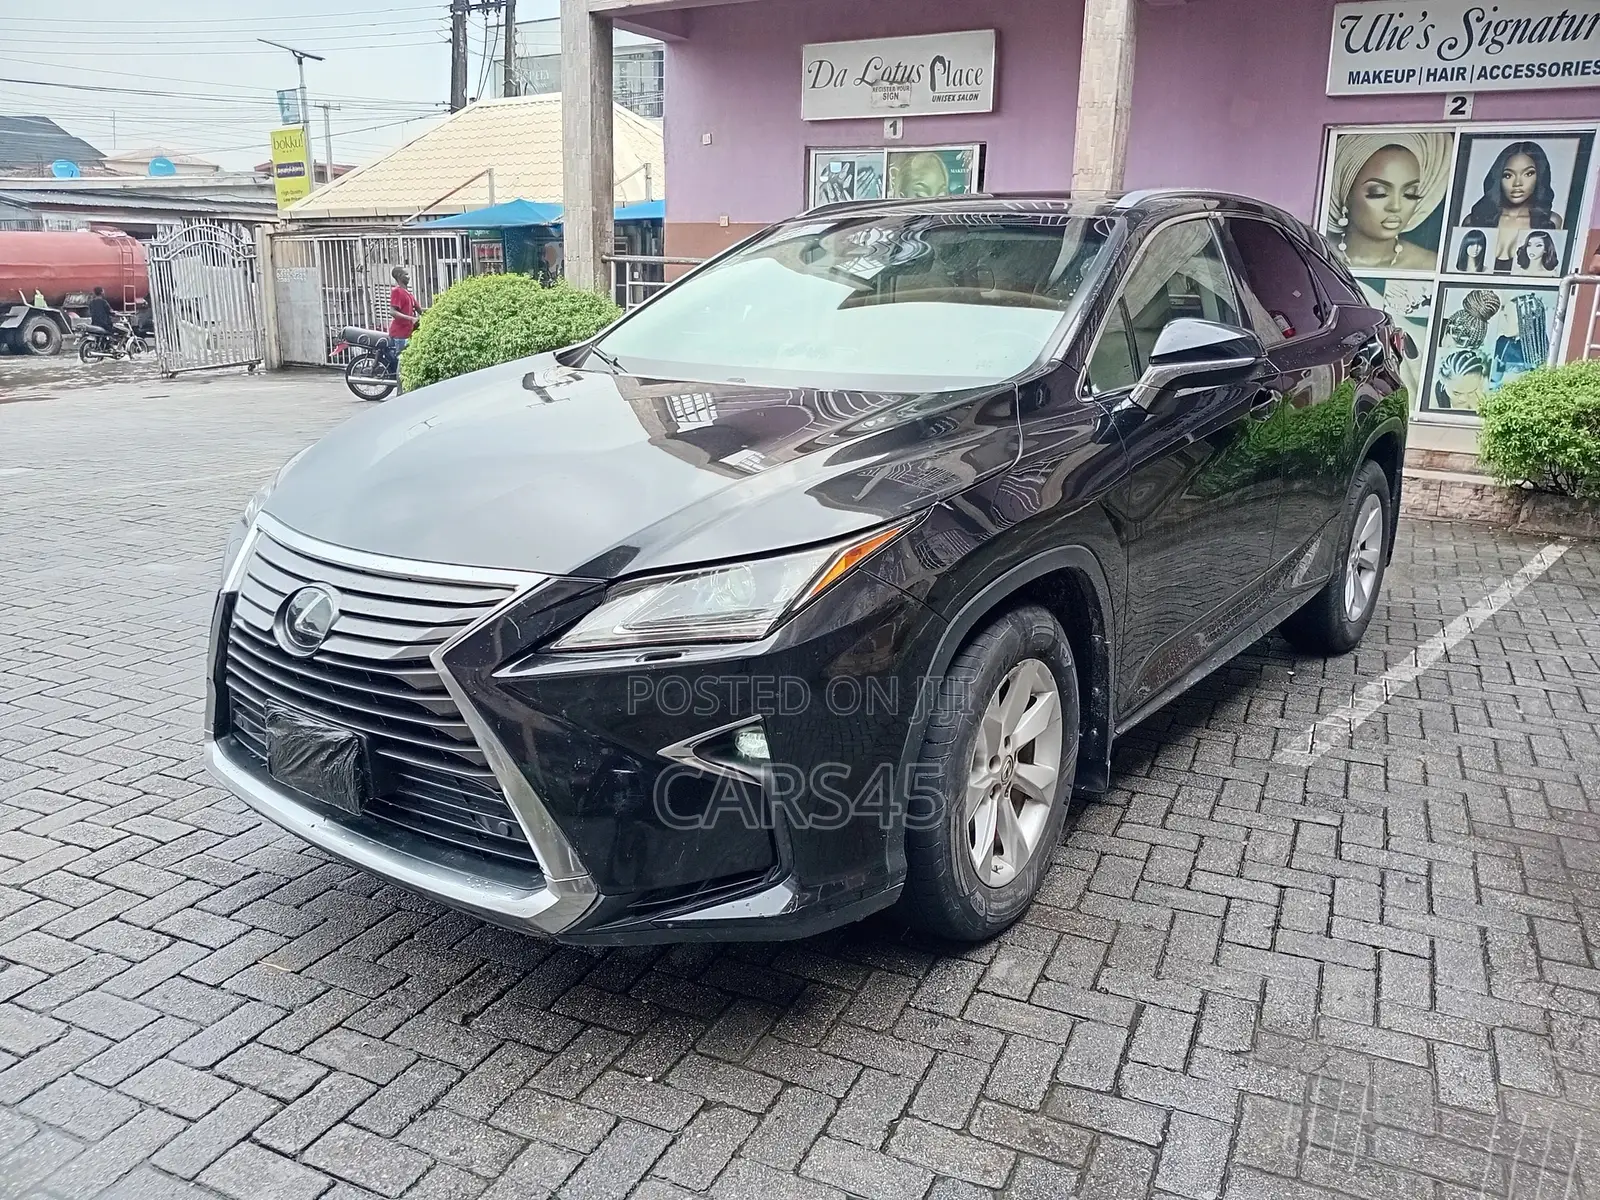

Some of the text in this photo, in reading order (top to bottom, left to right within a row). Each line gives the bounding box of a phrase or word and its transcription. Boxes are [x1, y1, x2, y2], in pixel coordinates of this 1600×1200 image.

[1340, 11, 1436, 54] Ulie's
[807, 59, 848, 89] Da
[853, 56, 924, 86] Lotus
[1347, 59, 1600, 86] MAKEUP HAIR ACCESSORIES
[882, 92, 899, 101] SIGN
[932, 93, 979, 103] UNISEX SALON
[1449, 97, 1468, 116] 2
[889, 120, 898, 136] 1
